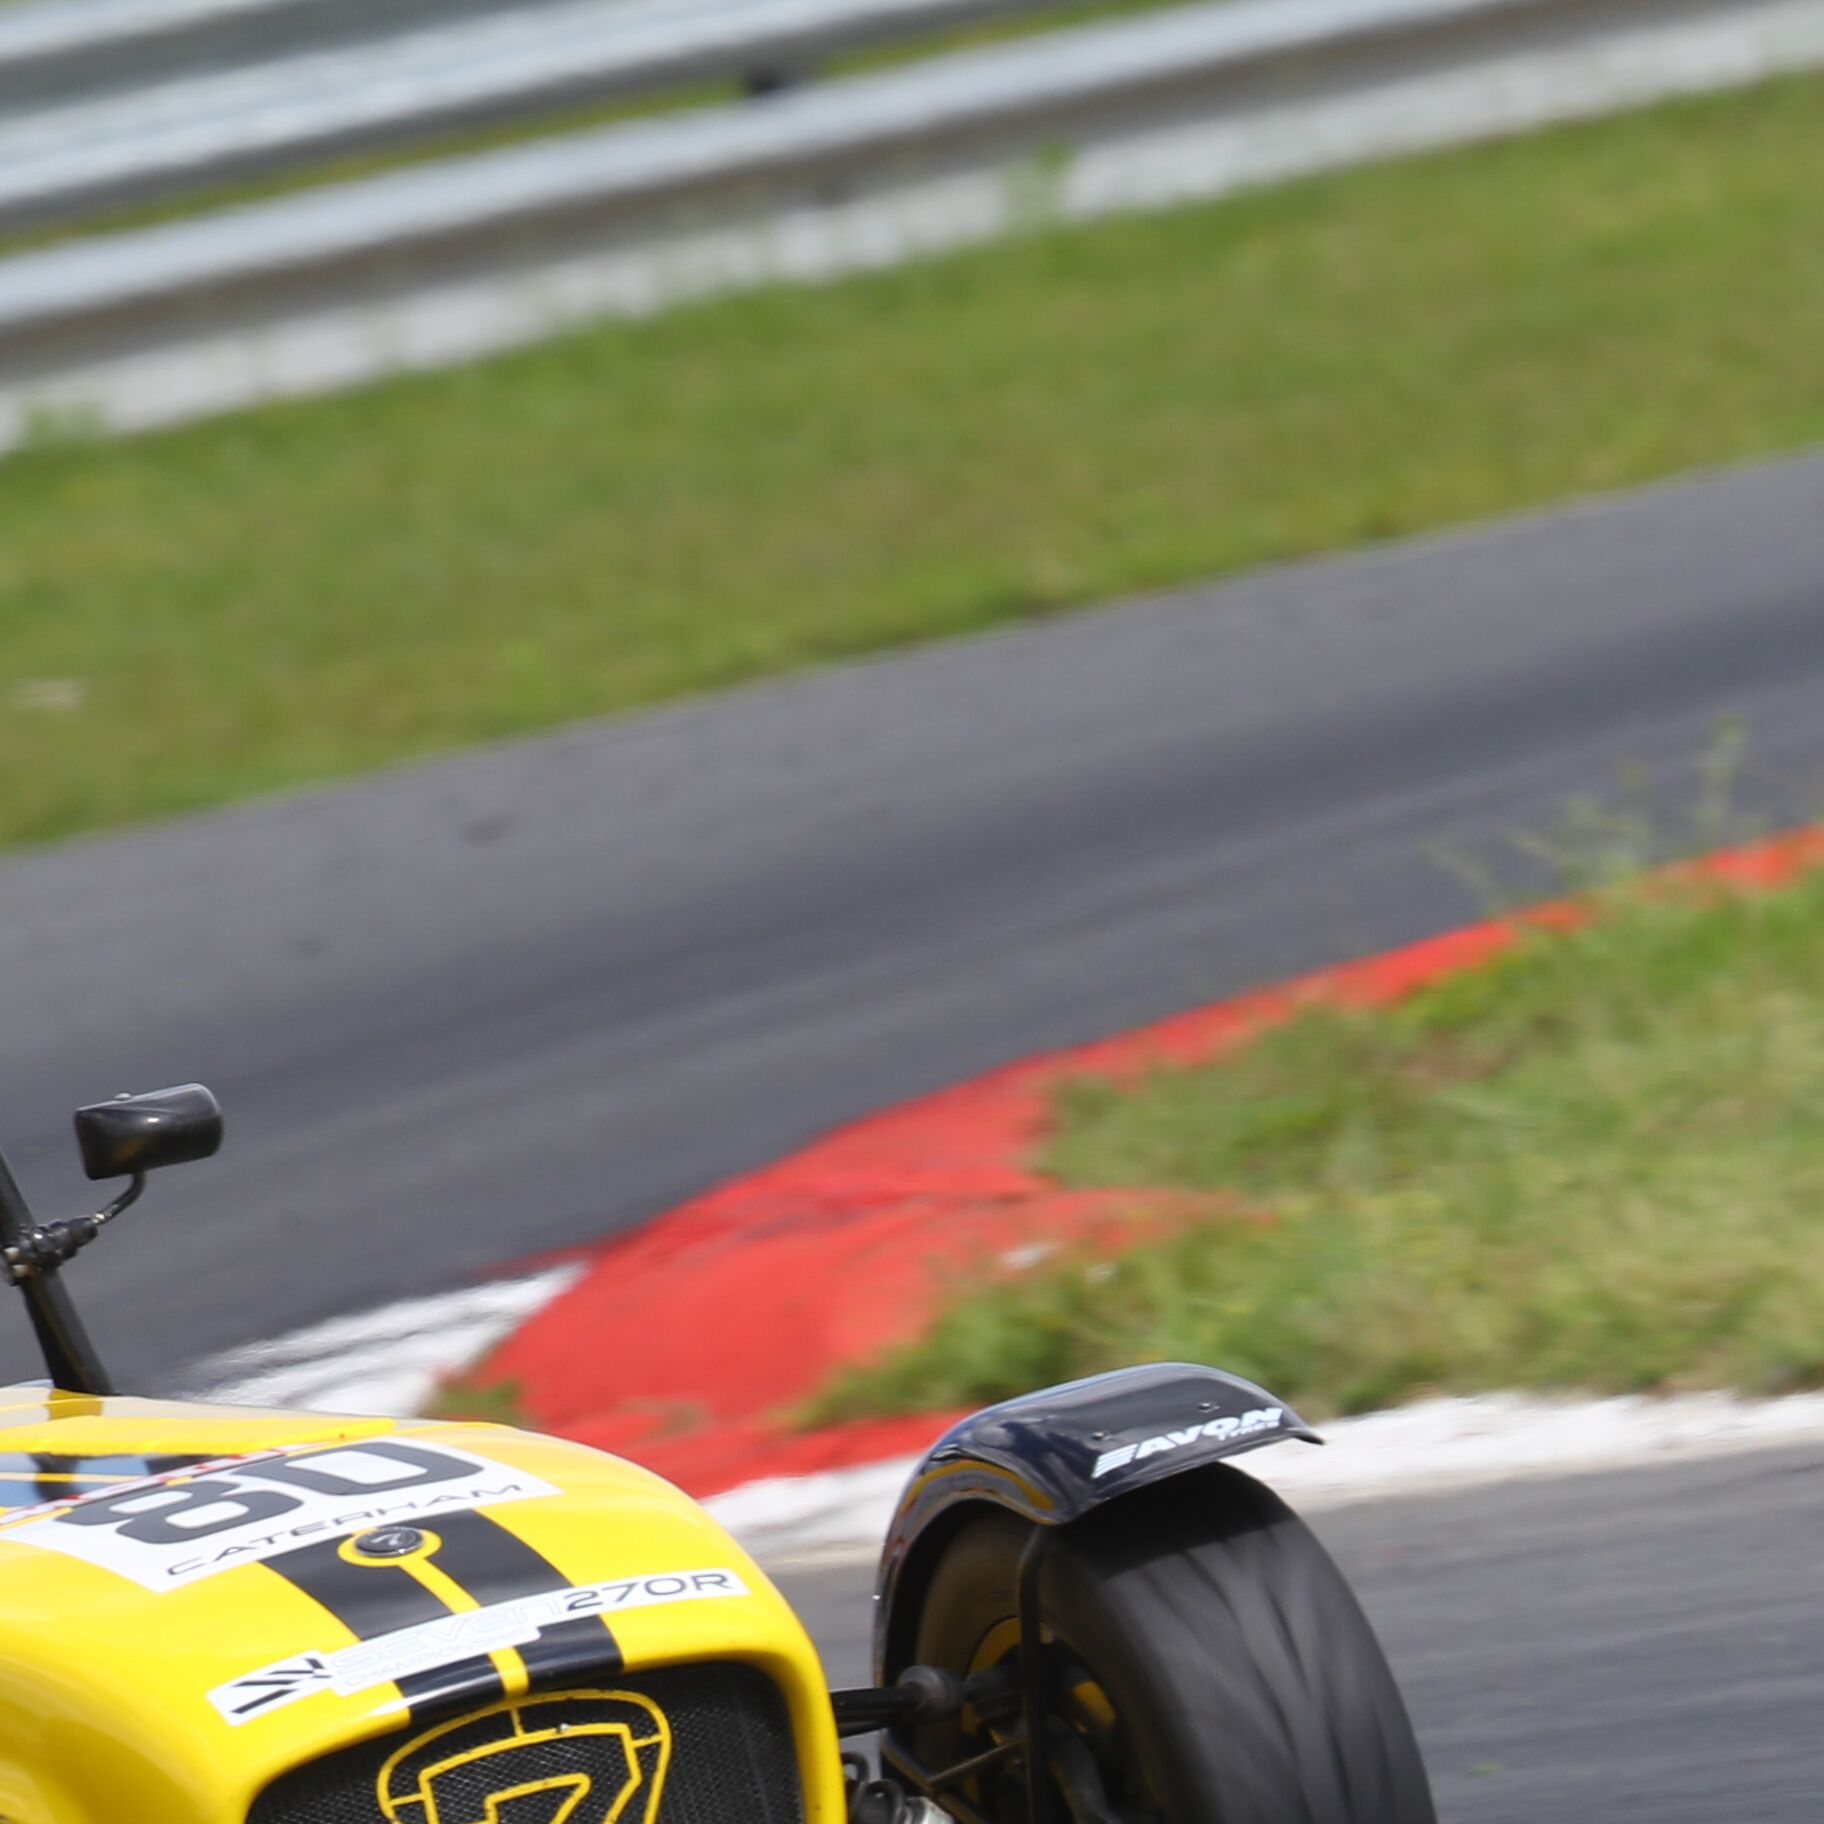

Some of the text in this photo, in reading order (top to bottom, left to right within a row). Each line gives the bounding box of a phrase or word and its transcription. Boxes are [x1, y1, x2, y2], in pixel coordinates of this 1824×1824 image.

[1136, 1407, 1284, 1460] AVON
[52, 1440, 485, 1545] 80
[166, 1483, 524, 1577] CATERHAM
[566, 1572, 734, 1612] 270R
